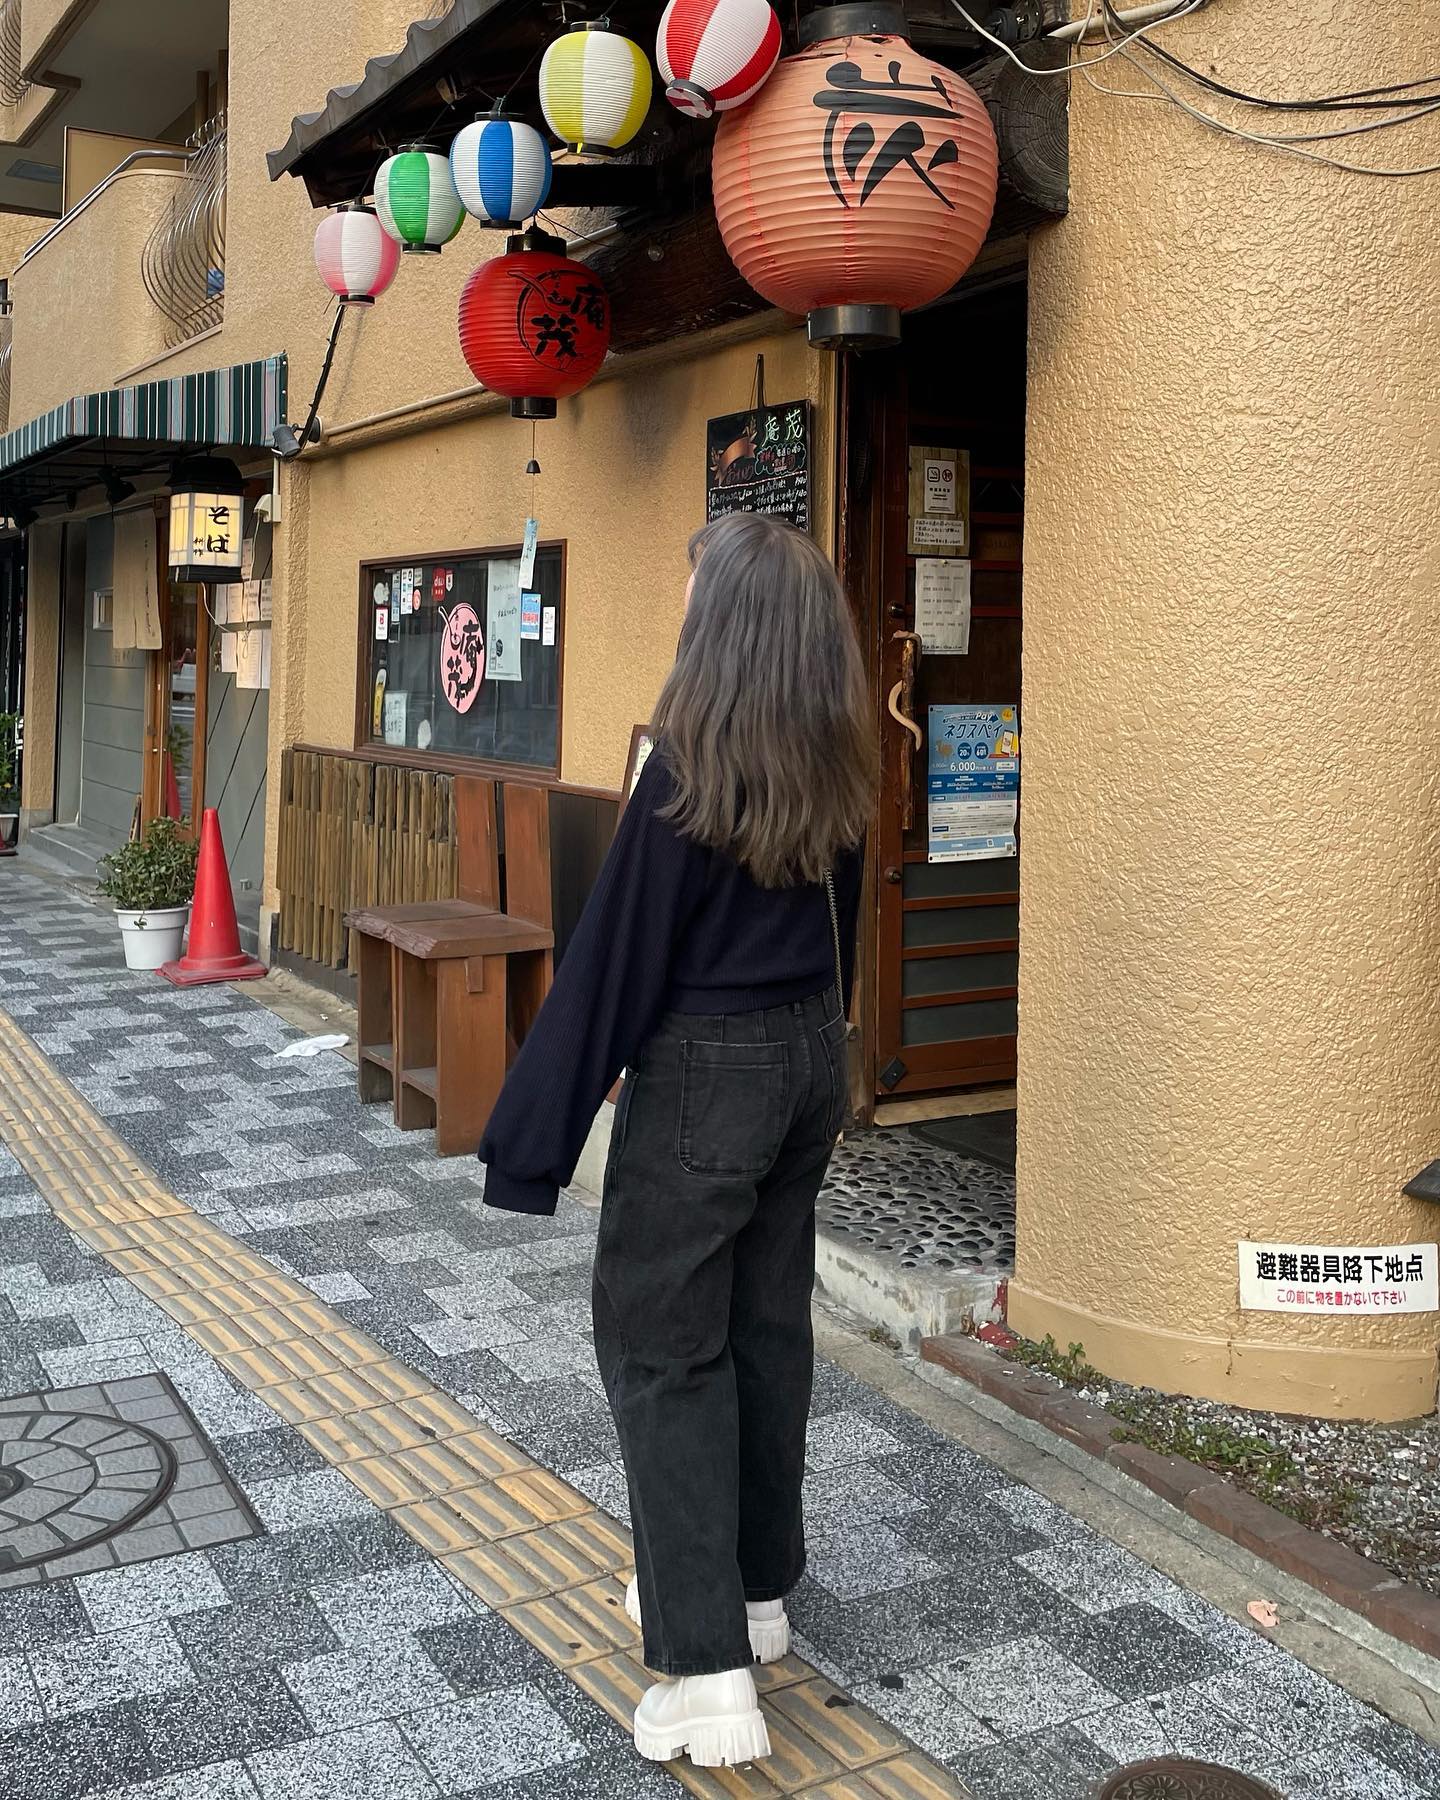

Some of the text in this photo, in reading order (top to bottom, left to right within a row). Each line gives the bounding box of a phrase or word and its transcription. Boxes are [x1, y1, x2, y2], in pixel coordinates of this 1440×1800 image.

[812, 60, 964, 210] 茂
[207, 506, 230, 553] そば
[975, 711, 993, 724] Pay
[944, 723, 1003, 739] ネクスペイ
[1256, 1251, 1423, 1284] 避難器具降下地点
[1277, 1288, 1407, 1306] この前に物を置かないで下さい
